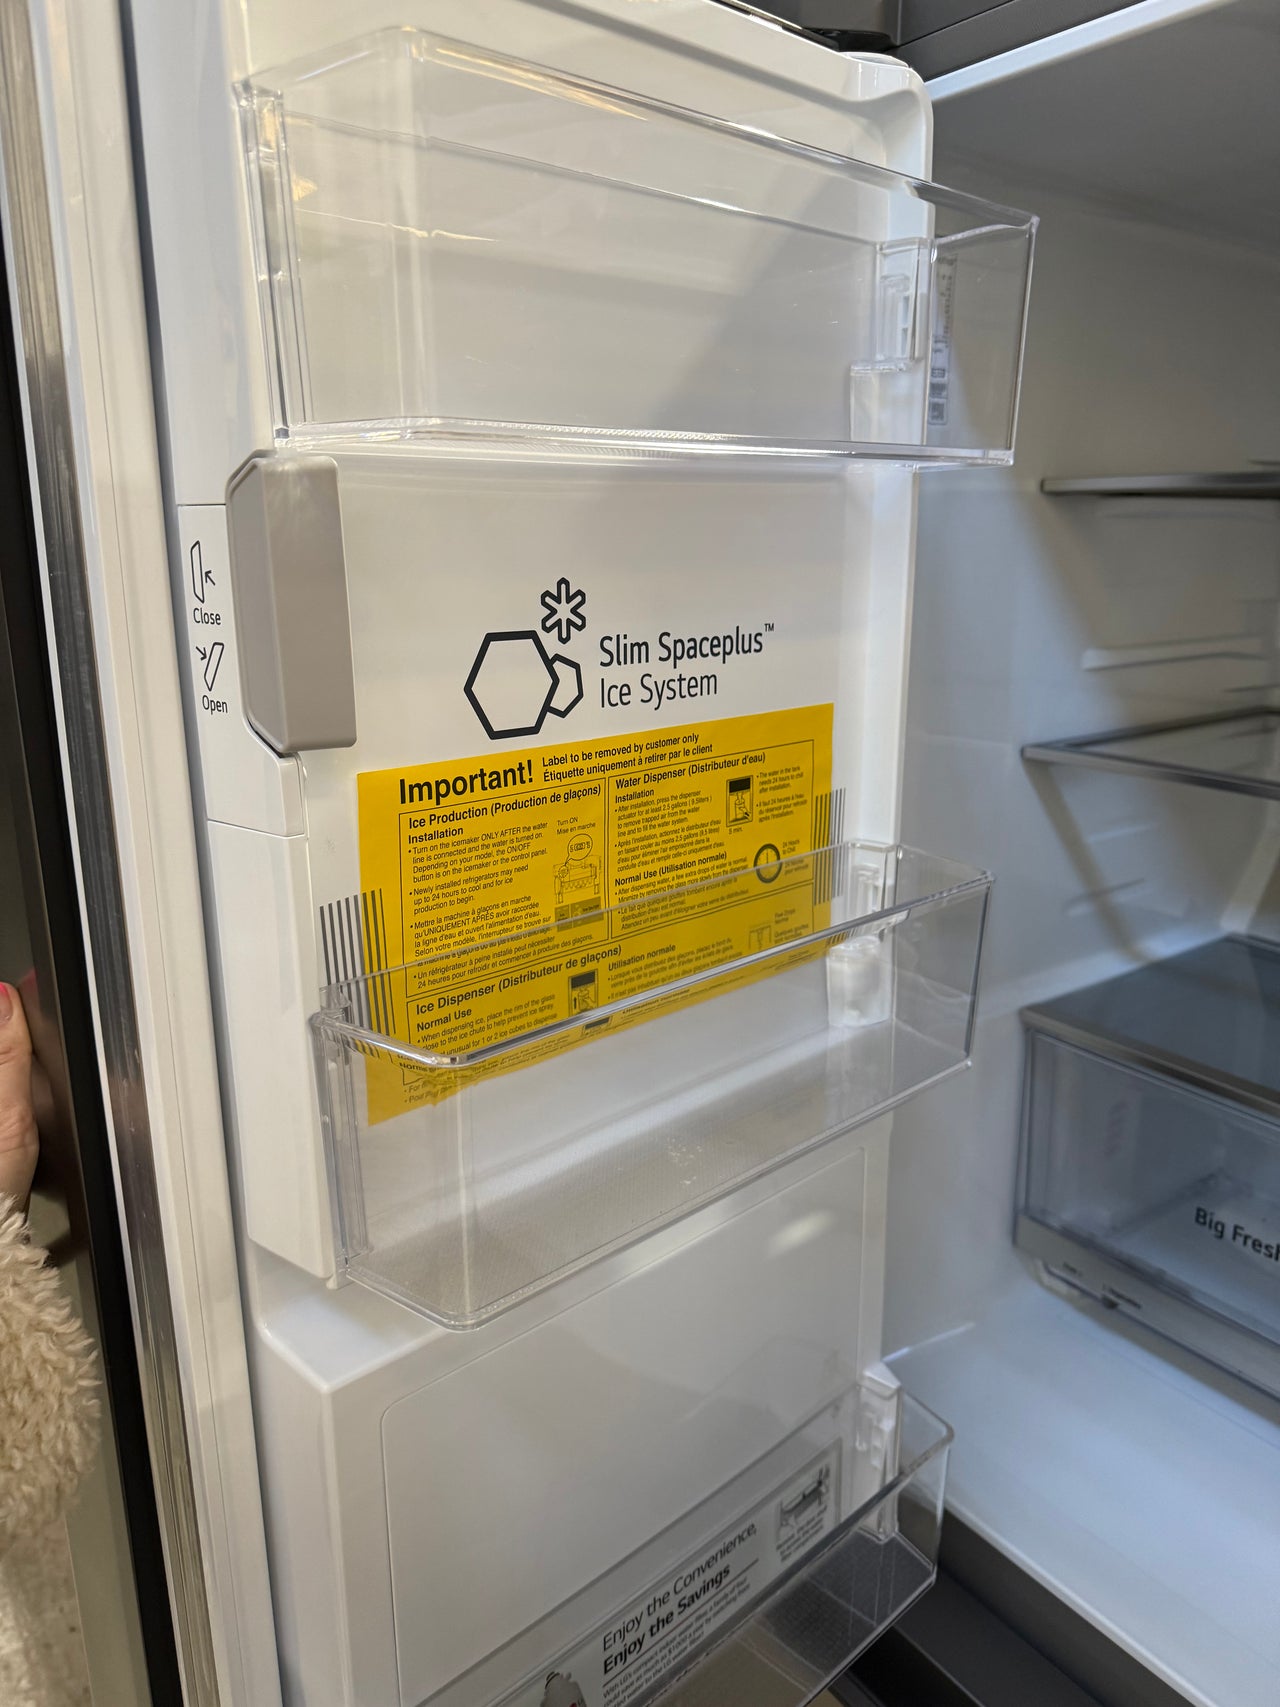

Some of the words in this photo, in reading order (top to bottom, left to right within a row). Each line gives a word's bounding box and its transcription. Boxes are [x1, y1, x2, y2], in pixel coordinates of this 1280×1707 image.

[193, 607, 221, 625] Close
[599, 634, 650, 667] Slim
[202, 695, 228, 715] Open
[600, 678, 632, 708] Ice
[640, 673, 718, 711] System
[542, 753, 568, 767] Label
[569, 752, 579, 763] to
[581, 750, 593, 761] be
[594, 743, 631, 759] removed
[633, 742, 643, 753] by
[645, 736, 680, 750] customer
[681, 732, 699, 744] only
[543, 766, 584, 782] Étiquette
[586, 757, 636, 775] uniquement
[637, 755, 643, 765] à
[644, 752, 667, 764] retirer
[668, 750, 681, 762] par
[683, 747, 690, 757] le
[691, 743, 712, 755] client
[399, 759, 533, 806] Important!
[615, 776, 641, 789] Water
[643, 768, 686, 784] Dispenser
[688, 758, 740, 777] (Distributeur
[741, 751, 765, 765] d'eau)
[408, 817, 426, 829] Ice
[429, 806, 487, 826] Production
[490, 795, 547, 816] (Production
[549, 791, 561, 803] de
[563, 783, 601, 803] glaçons)
[615, 788, 654, 804] Installation
[408, 827, 463, 844] Installation
[556, 827, 569, 835] Mise
[576, 822, 596, 830] marche
[568, 816, 578, 824] ON
[411, 846, 428, 854] Turn
[429, 844, 438, 852] on
[439, 841, 450, 849] the
[451, 836, 480, 847] icemaker
[480, 830, 499, 841] ONLY
[499, 826, 521, 838] AFTER
[522, 825, 531, 833] the
[532, 822, 548, 830] water
[412, 856, 425, 864] line
[425, 854, 432, 862] is
[433, 846, 466, 860] connected
[467, 844, 480, 853] and
[480, 842, 491, 850] the
[491, 839, 508, 848] water
[515, 832, 534, 843] turned
[412, 860, 448, 874] Depending
[449, 858, 458, 866] on
[458, 855, 473, 866] your
[495, 848, 505, 856] the
[412, 873, 434, 883] button
[435, 870, 441, 878] is
[441, 869, 451, 877] on
[451, 866, 462, 875] the
[463, 860, 491, 872] icemaker
[499, 856, 510, 864] the
[510, 851, 530, 862] control
[614, 872, 641, 887] Normal
[643, 869, 658, 879] Use
[658, 859, 696, 877] (Utilisation
[697, 850, 727, 866] normale)
[413, 885, 433, 896] Newly
[434, 878, 461, 891] installed
[462, 871, 499, 885] refrigerators
[500, 868, 513, 876] may
[513, 863, 528, 873] need
[413, 897, 422, 906] up
[423, 895, 430, 903] to
[431, 892, 440, 901] 24
[441, 889, 459, 899] hours
[467, 882, 481, 893] cool
[482, 879, 494, 889] and
[495, 878, 503, 886] for
[504, 876, 513, 884] ice
[413, 901, 448, 917] production
[414, 919, 435, 930] Mettre
[436, 916, 442, 924] la
[443, 910, 470, 922] machine
[470, 907, 476, 915] à
[476, 902, 500, 915] glaçons
[500, 900, 509, 908] en
[509, 895, 531, 905] marche
[607, 953, 645, 971] Utilisation
[646, 944, 676, 959] normale
[416, 1002, 434, 1015] Ice
[437, 983, 495, 1009] Dispenser
[498, 962, 563, 992] (Distributeur
[565, 958, 578, 969] de
[579, 943, 621, 967] glaçons)
[416, 1012, 451, 1032] Normal
[453, 1008, 472, 1020] Use
[1195, 1206, 1225, 1239] Big
[603, 1611, 644, 1652] Enjoy
[646, 1591, 671, 1617] the
[673, 1523, 757, 1595] Convenience,
[603, 1633, 646, 1675] Enjoy
[649, 1611, 674, 1637] the
[677, 1564, 731, 1616] Savings
